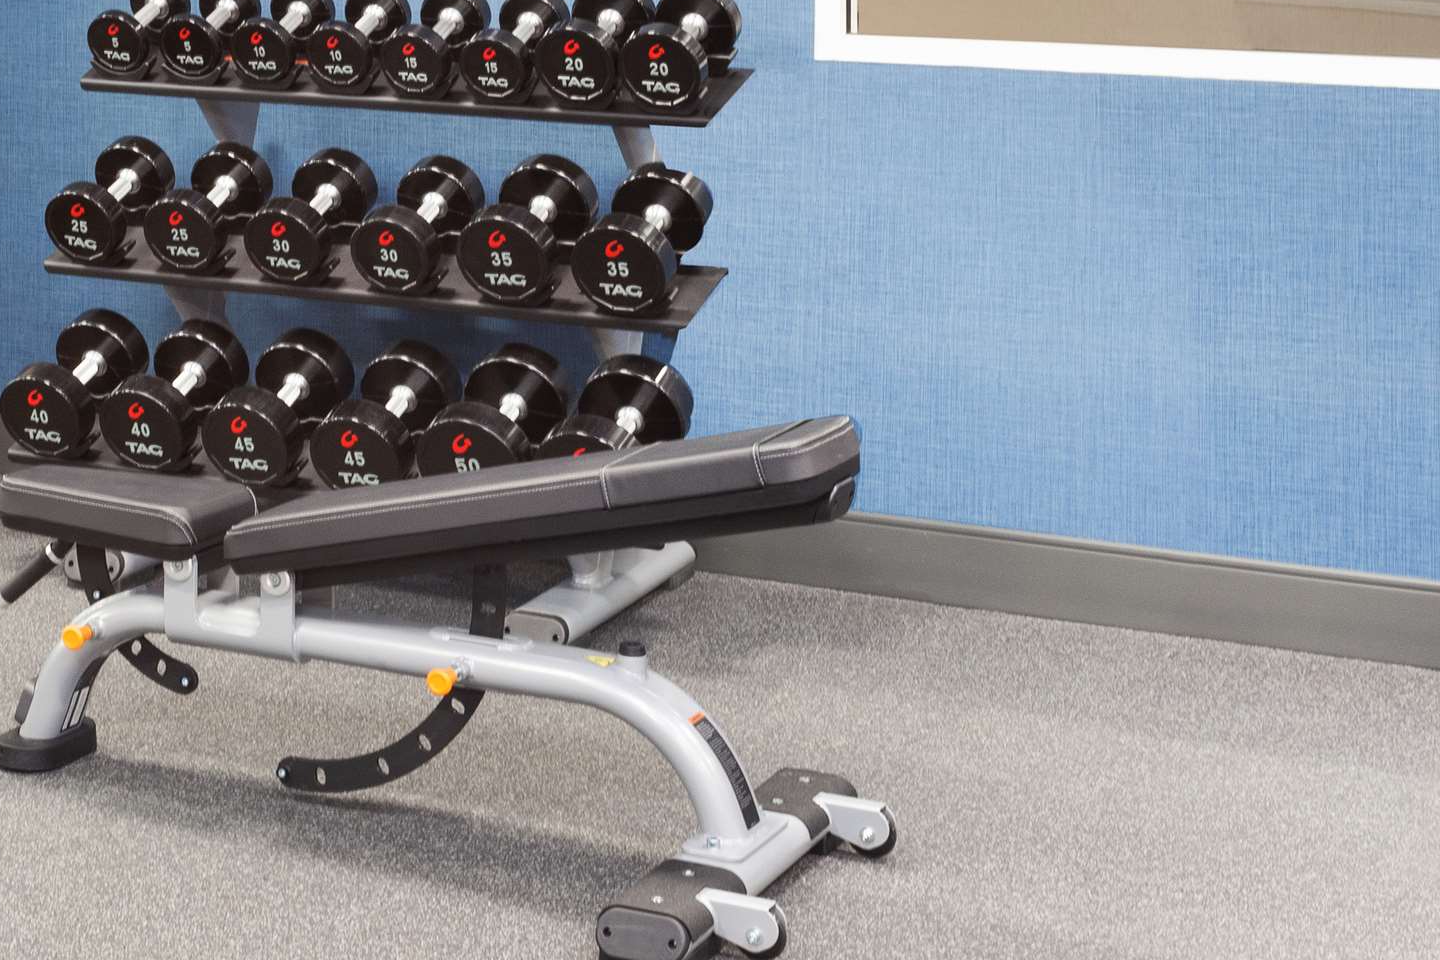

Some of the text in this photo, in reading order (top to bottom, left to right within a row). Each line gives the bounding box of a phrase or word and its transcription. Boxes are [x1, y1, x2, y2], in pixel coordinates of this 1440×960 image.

[112, 37, 119, 47] 5
[184, 41, 191, 52] 5
[103, 49, 130, 61] TAG
[253, 46, 266, 58] 10
[329, 49, 342, 61] 10
[177, 55, 204, 65] TAG
[248, 60, 276, 71] TAG
[404, 57, 417, 69] 15
[565, 58, 583, 71] 20
[324, 65, 353, 75] TAG
[485, 62, 497, 73] 15
[650, 62, 668, 76] 20
[399, 72, 427, 82] TAG
[478, 77, 508, 88] TAG
[558, 75, 594, 88] TAG
[642, 80, 680, 94] TAG
[71, 219, 88, 233] 25
[171, 227, 188, 241] 25
[64, 234, 96, 250] TAG
[273, 239, 290, 253] 30
[166, 245, 200, 258] TAG
[380, 248, 397, 263] 30
[266, 255, 301, 269] TAG
[491, 251, 512, 267] 35
[373, 265, 409, 279] TAG
[607, 261, 629, 277] 35
[484, 273, 526, 287] TAG
[599, 282, 642, 297] TAG
[30, 409, 48, 424] 40
[24, 427, 61, 443] TAG
[131, 422, 150, 438] 40
[125, 441, 163, 456] TAG
[234, 437, 254, 452] 45
[229, 457, 268, 472] TAG
[344, 451, 365, 466] 45
[454, 458, 480, 473] 50
[338, 472, 380, 485] TAG
